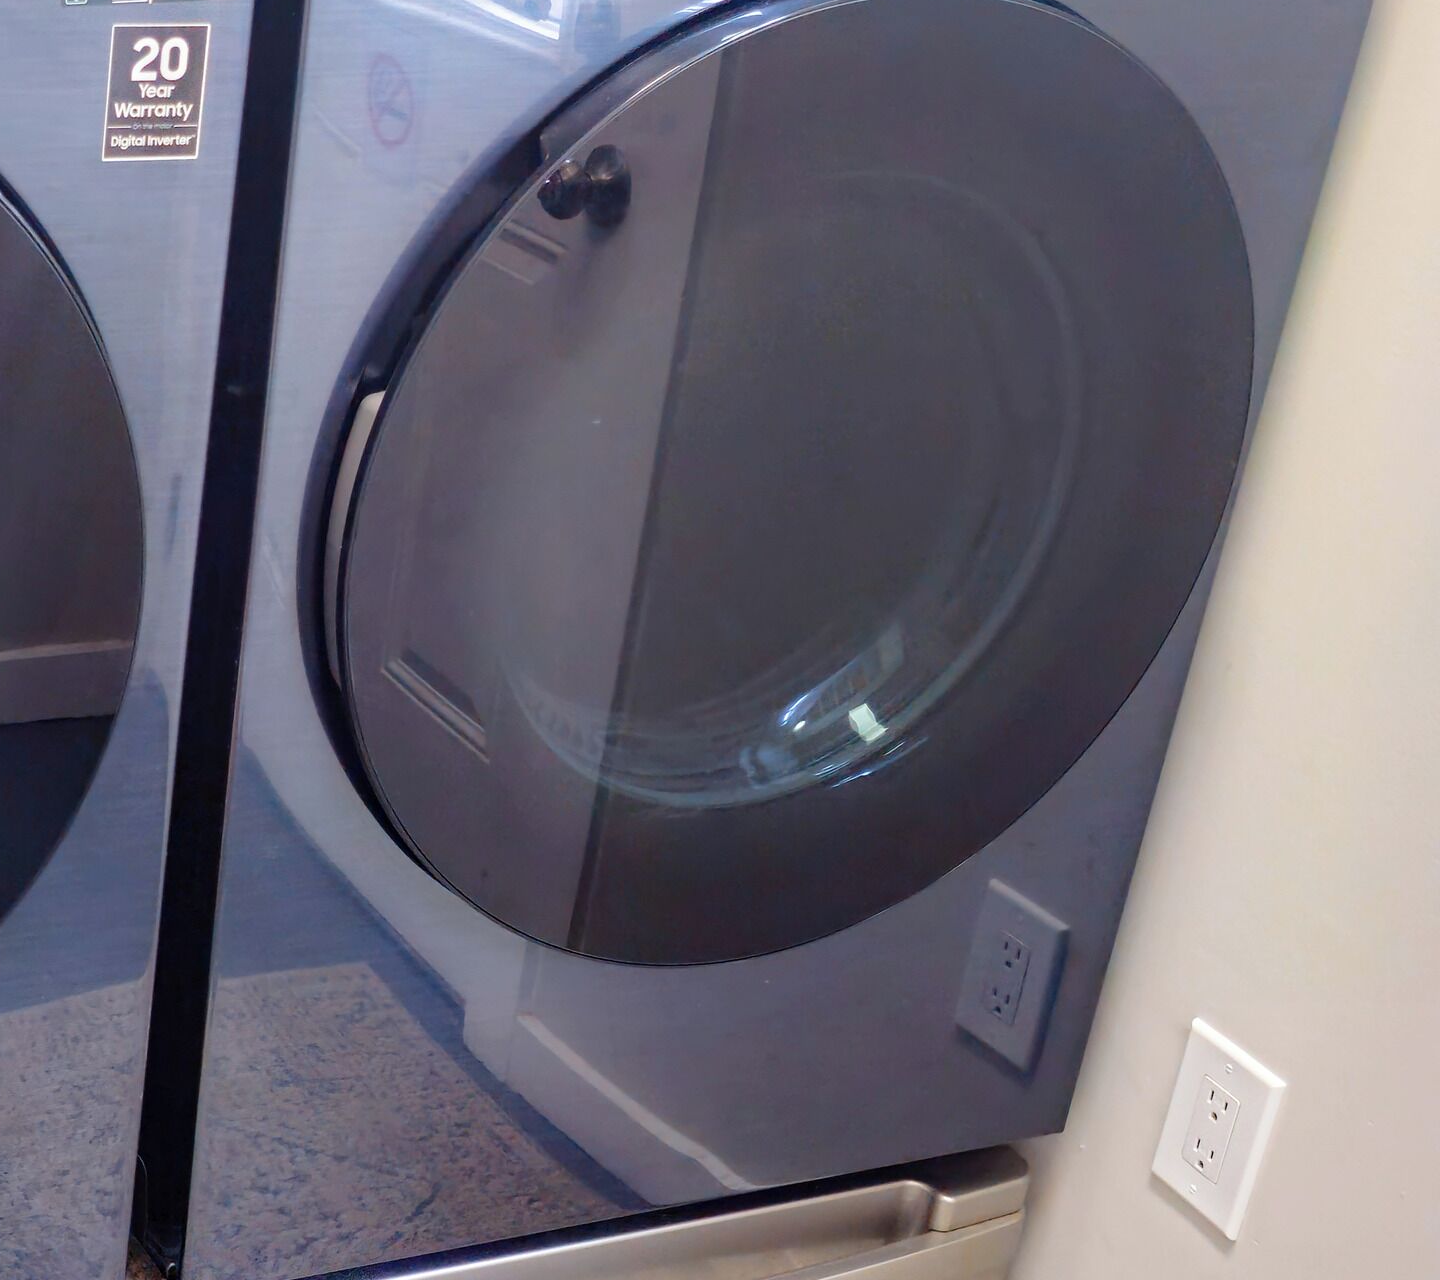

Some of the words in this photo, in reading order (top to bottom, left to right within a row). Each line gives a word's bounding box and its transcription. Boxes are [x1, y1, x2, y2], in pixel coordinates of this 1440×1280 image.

[131, 36, 190, 82] 20
[139, 83, 176, 99] Year
[114, 101, 194, 122] Warranty
[110, 134, 146, 150] Digital
